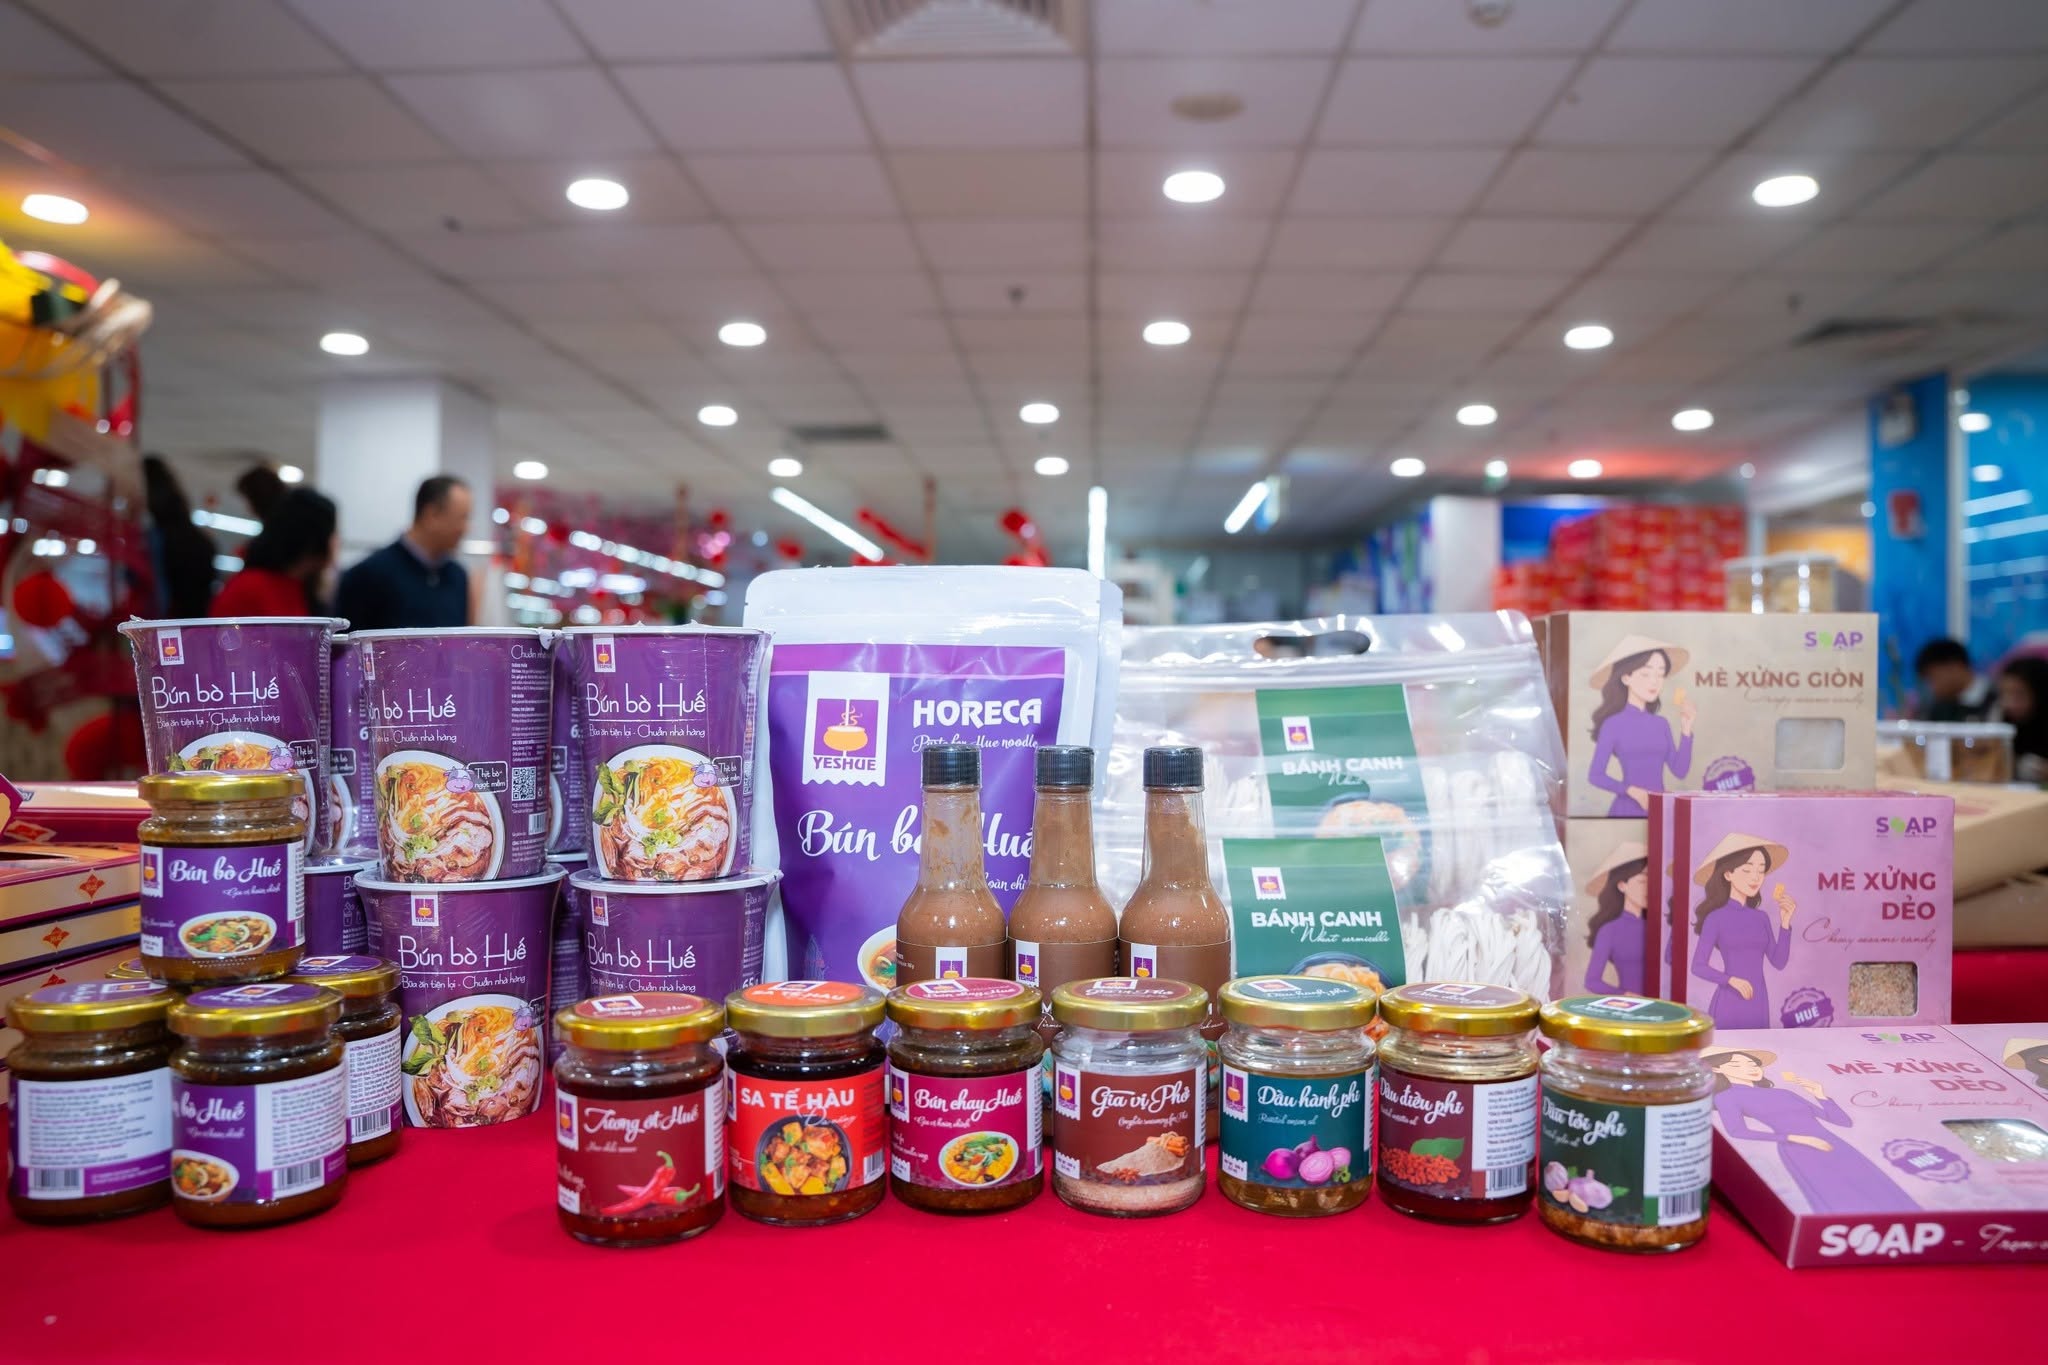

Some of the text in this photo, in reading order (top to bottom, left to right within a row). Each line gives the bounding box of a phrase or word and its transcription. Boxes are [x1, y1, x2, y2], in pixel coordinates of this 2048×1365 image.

[152, 671, 279, 709] Bún bò Huế
[586, 683, 706, 716] Bún bò Huế
[382, 690, 402, 719] bò
[408, 688, 456, 722] Huế
[912, 698, 1042, 729] HORECA
[436, 731, 456, 743] hàng
[686, 725, 705, 738] hàng
[813, 756, 877, 771] YESHUE
[1281, 756, 1403, 775] BÁNH CANH
[798, 809, 881, 861] Bún
[168, 856, 282, 884] Bún bò Huế
[1818, 865, 1936, 891] MÈ XỬNG
[1251, 908, 1382, 928] BÁNH CANH
[1881, 895, 1936, 920] DẺO
[398, 935, 442, 969] Bún
[450, 936, 477, 966] bò
[484, 933, 526, 967] Huế
[588, 932, 696, 973] Bún bò Huế
[462, 975, 493, 989] Chuẩn
[494, 974, 509, 986] nhà
[509, 973, 526, 984] hàng
[676, 978, 696, 993] hàng
[1827, 1059, 1881, 1075] MÈ
[196, 1098, 246, 1125] Huế
[741, 1087, 855, 1111] SA TẾ HÀU
[914, 1088, 1023, 1122] Bún chay Huế
[1091, 1080, 1191, 1118] Gia vị Phở
[1258, 1085, 1298, 1108] Dầu
[1298, 1084, 1340, 1110] hành
[1331, 1080, 1361, 1118] phi
[1400, 1084, 1434, 1111] điều
[1424, 1090, 1464, 1124] phi
[660, 1103, 699, 1131] Huế
[1583, 1110, 1627, 1146] phi
